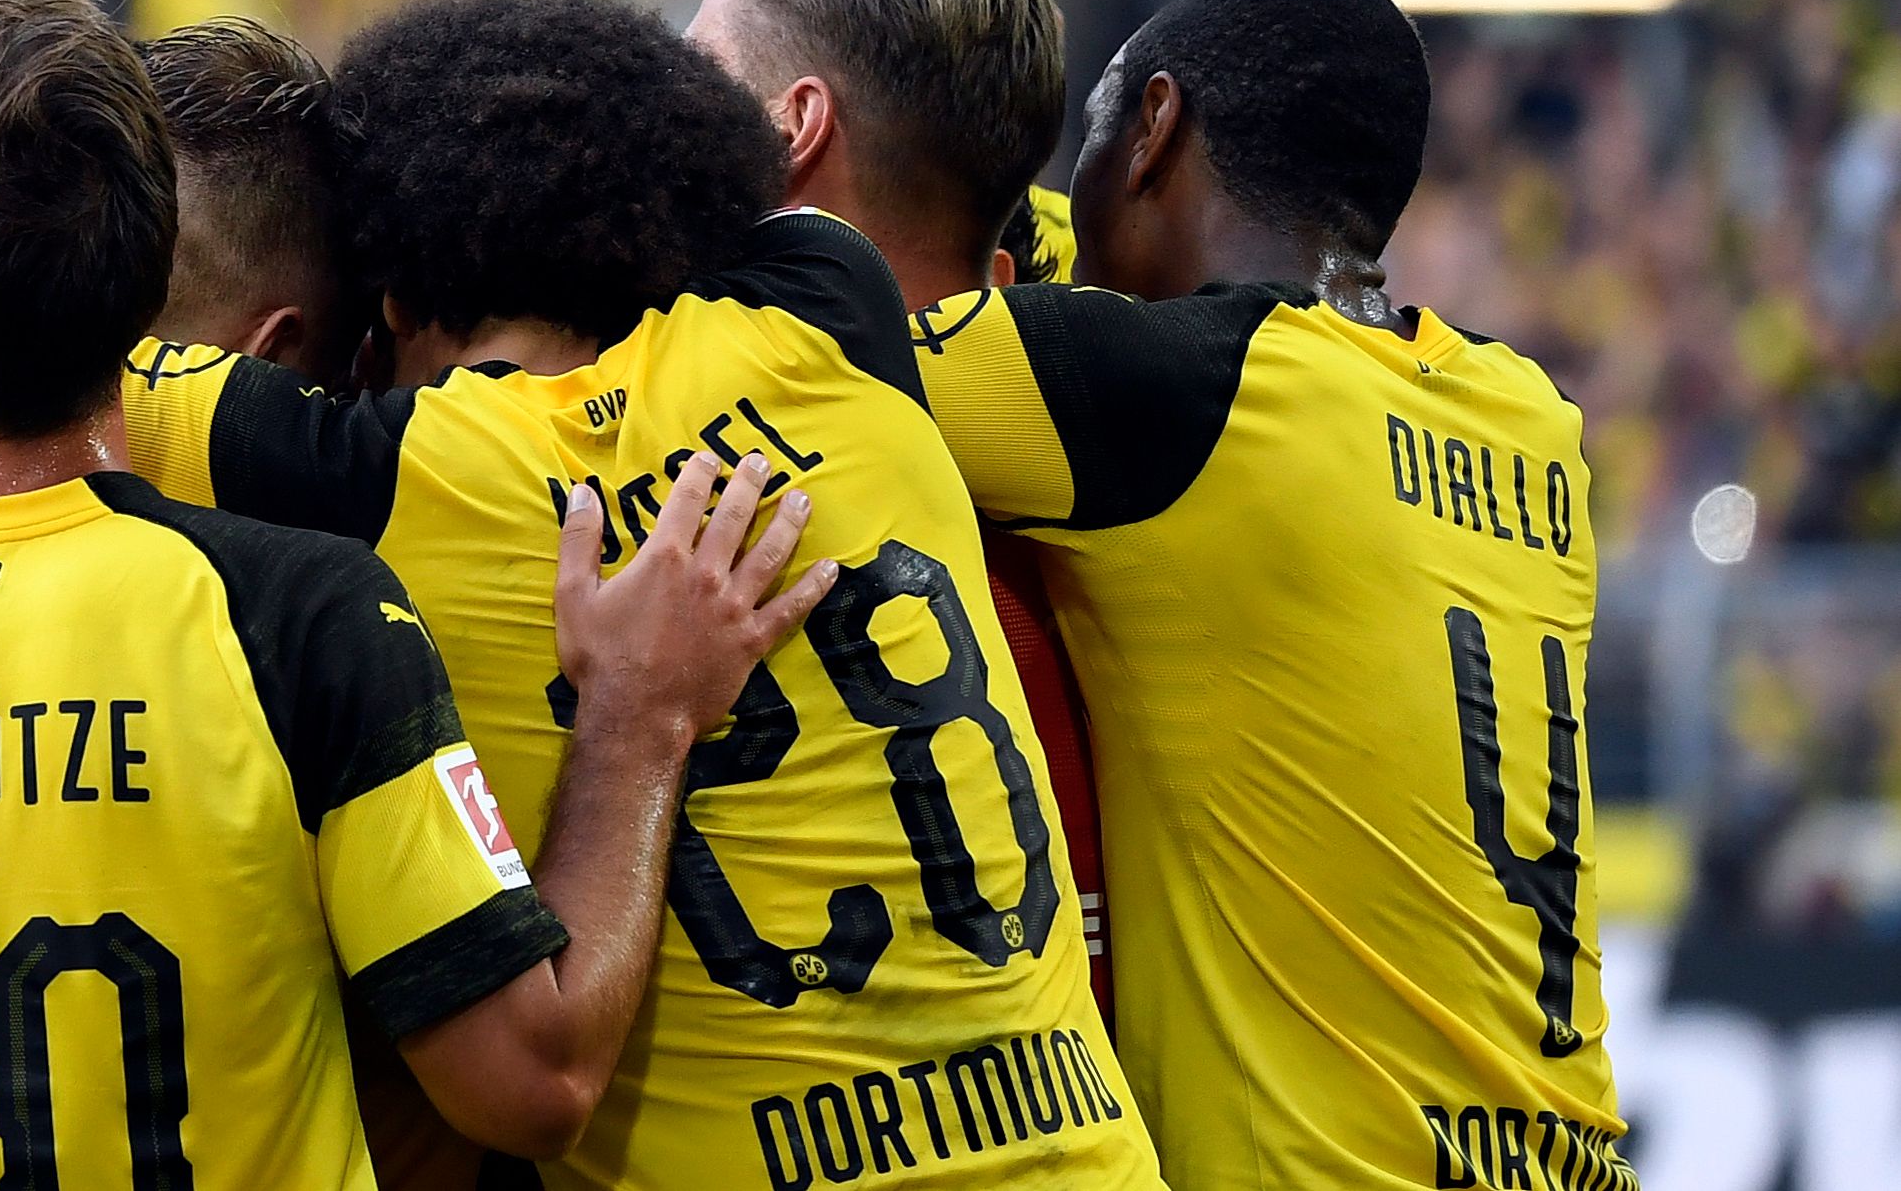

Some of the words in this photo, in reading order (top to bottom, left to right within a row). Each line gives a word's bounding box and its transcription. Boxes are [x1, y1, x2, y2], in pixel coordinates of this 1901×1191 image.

[1387, 412, 1573, 558] DIALLO
[1444, 605, 1583, 1058] 4
[796, 955, 825, 978] BVB
[751, 1028, 1123, 1191] DORTMUND
